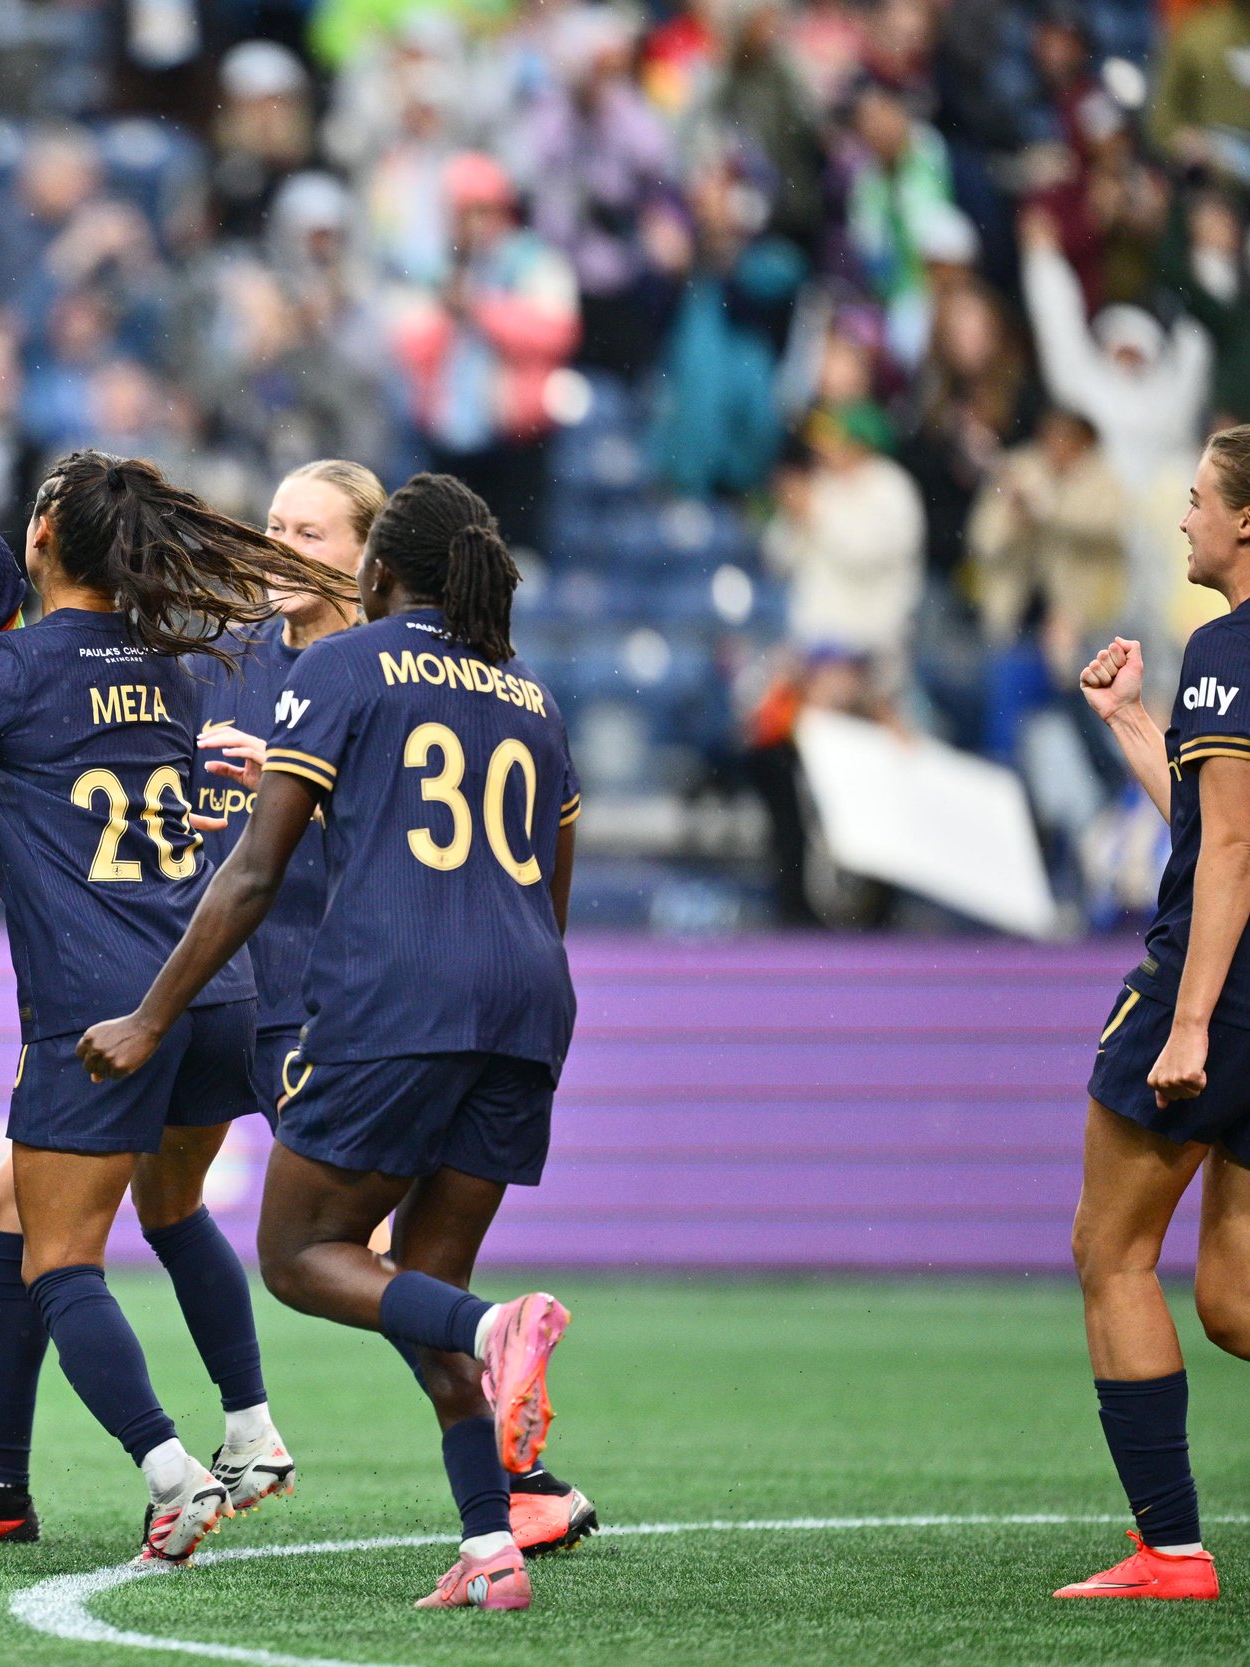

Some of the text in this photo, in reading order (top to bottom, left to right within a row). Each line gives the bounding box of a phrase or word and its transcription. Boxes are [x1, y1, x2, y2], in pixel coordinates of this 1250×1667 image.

[79, 647, 121, 657] PAULA'S
[105, 656, 144, 664] SKINCARE
[378, 650, 547, 718] MONDESIR
[1183, 677, 1239, 715] ally
[89, 685, 172, 725] MEZA
[275, 689, 311, 729] lly
[71, 765, 204, 882] 20
[403, 722, 543, 886] 30
